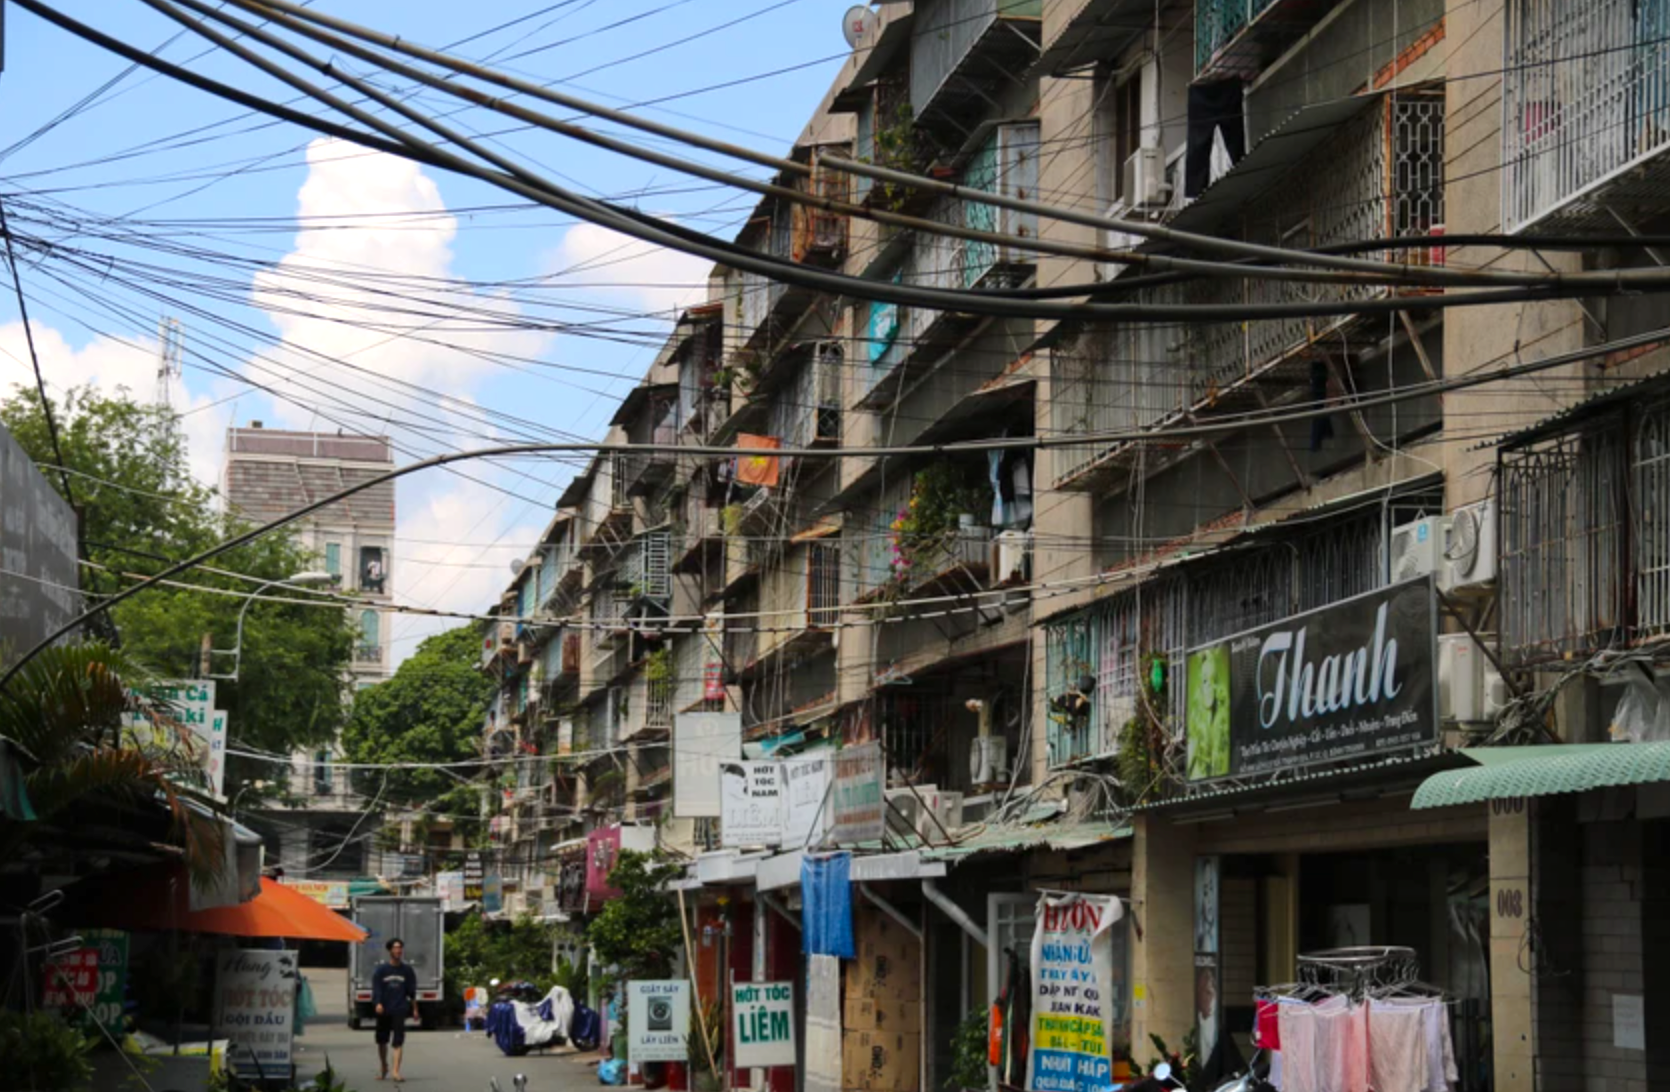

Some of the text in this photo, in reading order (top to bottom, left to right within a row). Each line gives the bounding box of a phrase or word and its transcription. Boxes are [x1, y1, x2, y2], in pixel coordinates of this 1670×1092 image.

[1256, 600, 1402, 728] Thanh
[753, 764, 774, 775] HỚT
[751, 788, 779, 797] NAM
[259, 984, 291, 1009] TÓC
[735, 984, 791, 1003] HỚT TÓC
